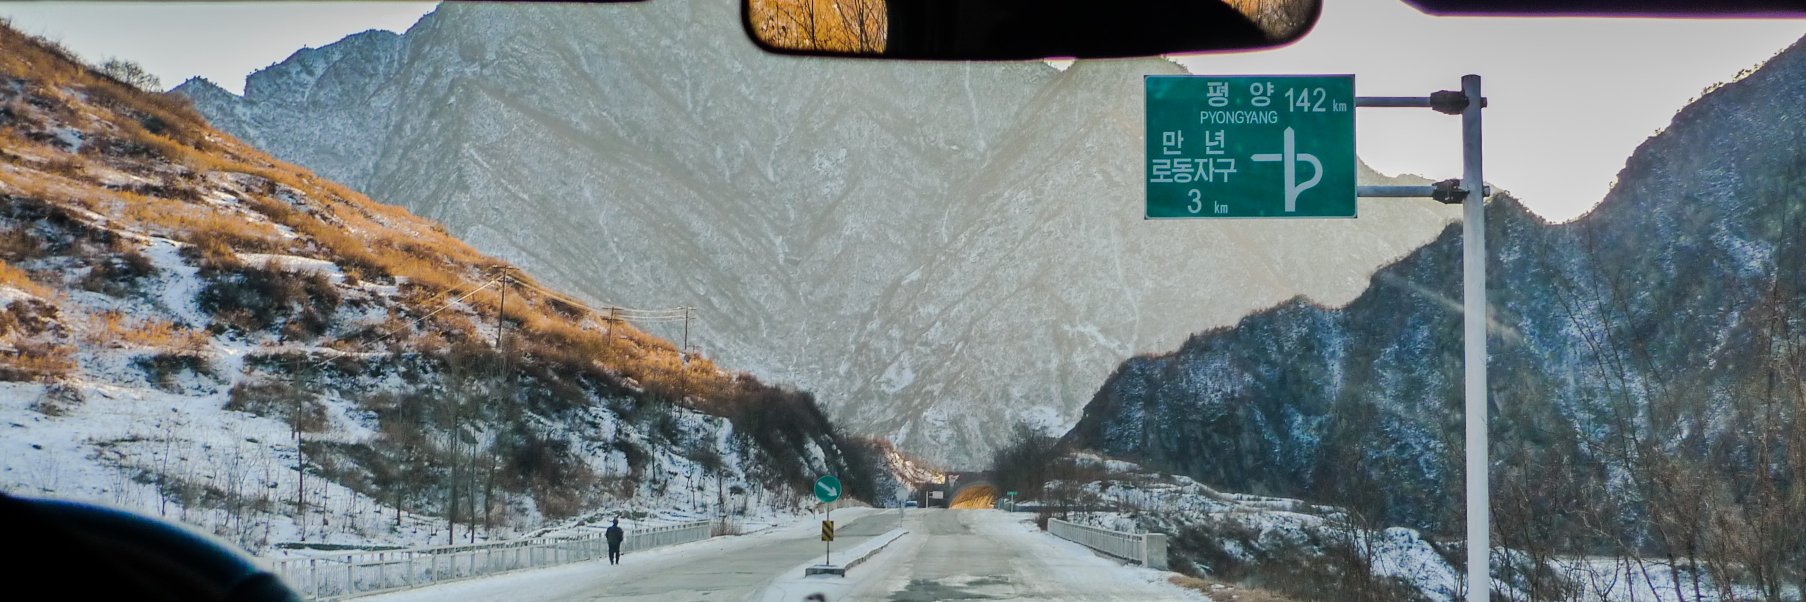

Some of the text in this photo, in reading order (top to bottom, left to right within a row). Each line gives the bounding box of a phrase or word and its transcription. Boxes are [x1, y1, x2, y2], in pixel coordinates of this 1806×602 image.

[1284, 87, 1326, 112] 142
[1332, 100, 1347, 112] km
[1199, 110, 1278, 125] PYONGYANG
[1150, 158, 1238, 184] 로동자구
[1187, 188, 1229, 214] 3 km
